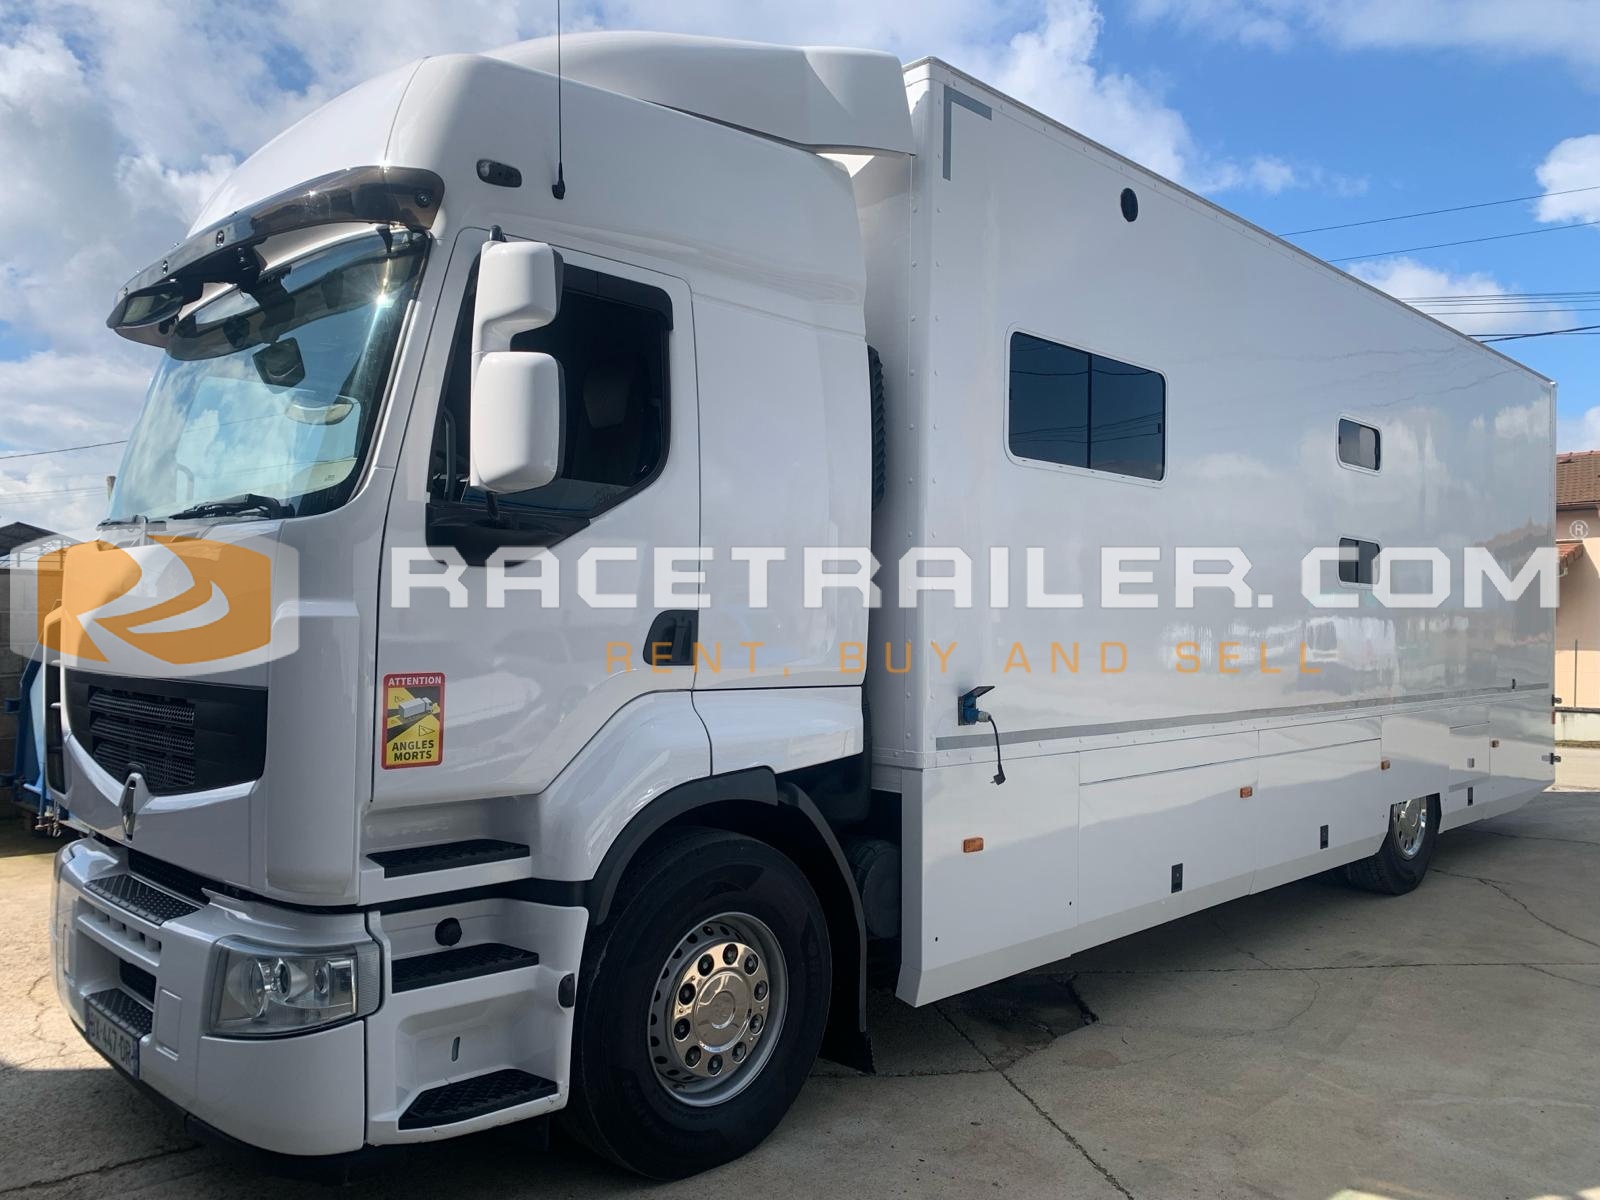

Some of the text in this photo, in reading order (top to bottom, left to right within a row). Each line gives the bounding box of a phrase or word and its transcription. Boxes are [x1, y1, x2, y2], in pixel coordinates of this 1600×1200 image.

[388, 676, 442, 686] ATTENTION
[392, 740, 435, 752] ANGLES
[393, 750, 433, 762] MORTS
